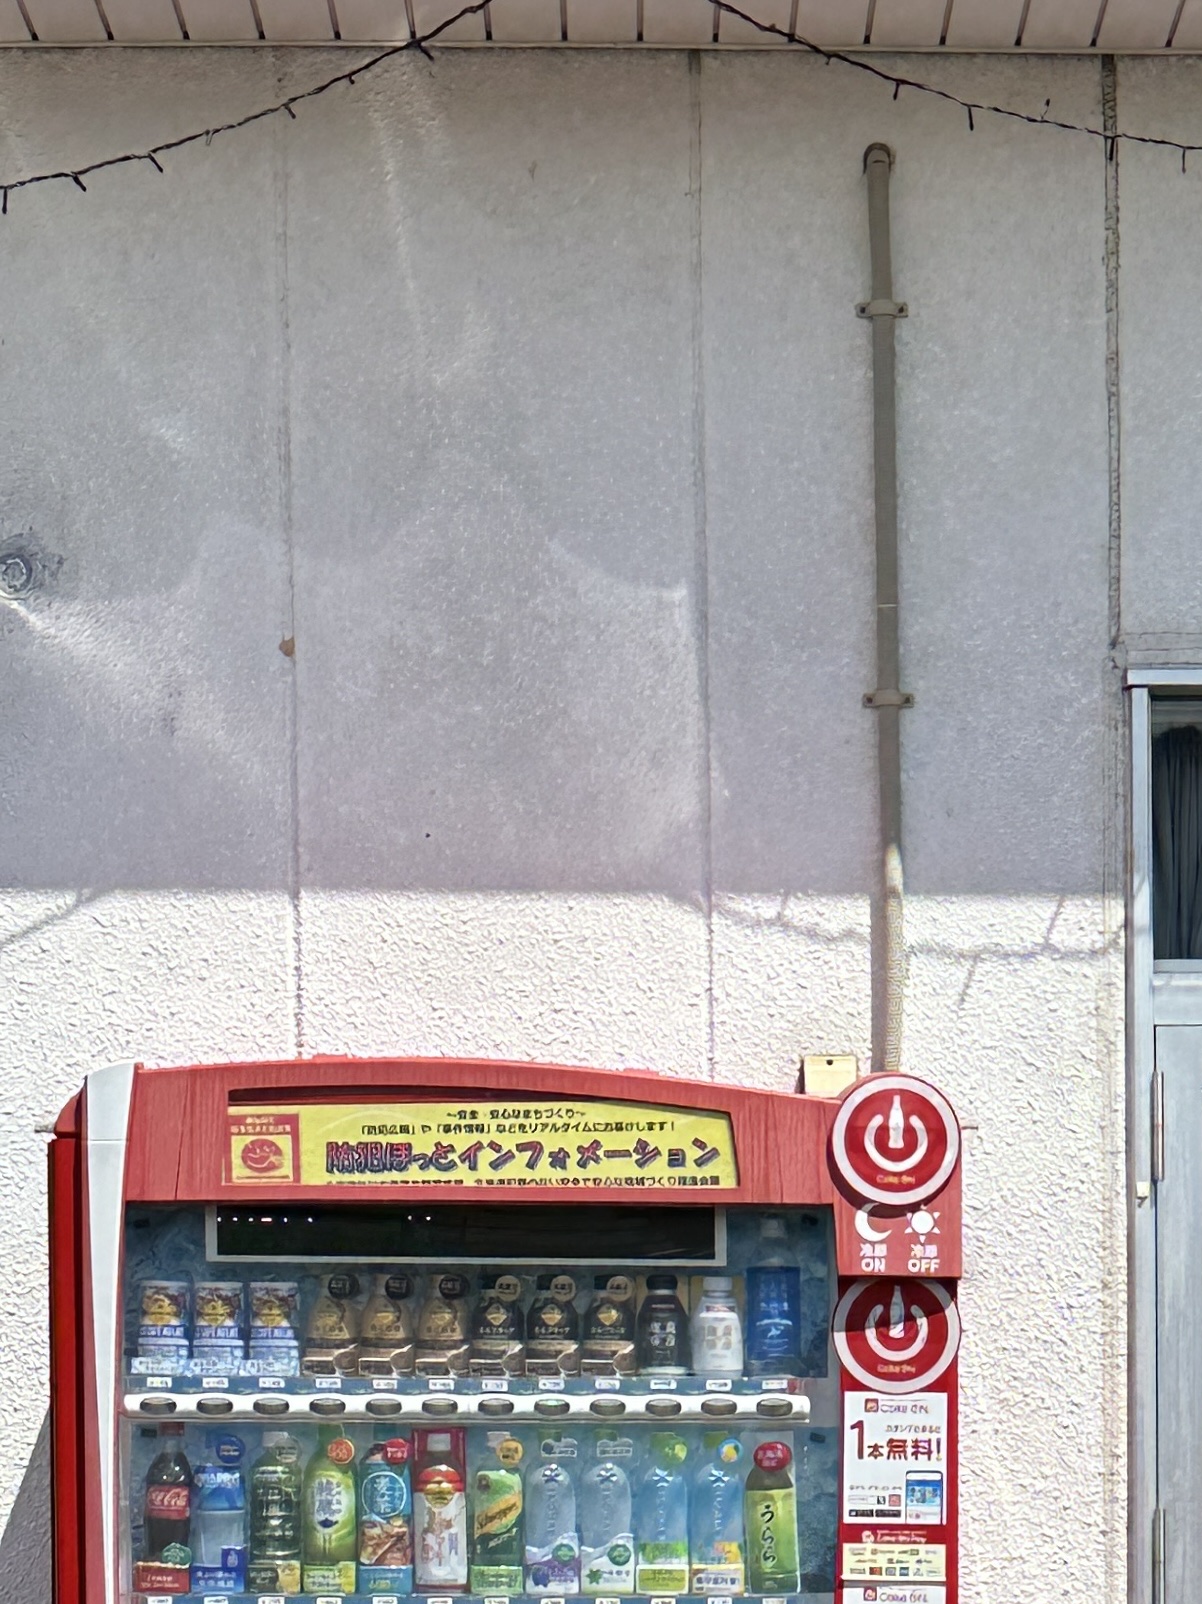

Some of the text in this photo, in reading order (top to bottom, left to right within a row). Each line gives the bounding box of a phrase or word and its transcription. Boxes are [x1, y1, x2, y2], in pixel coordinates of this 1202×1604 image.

[861, 1259, 940, 1272] ON OFF
[759, 1504, 777, 1564] うらら
